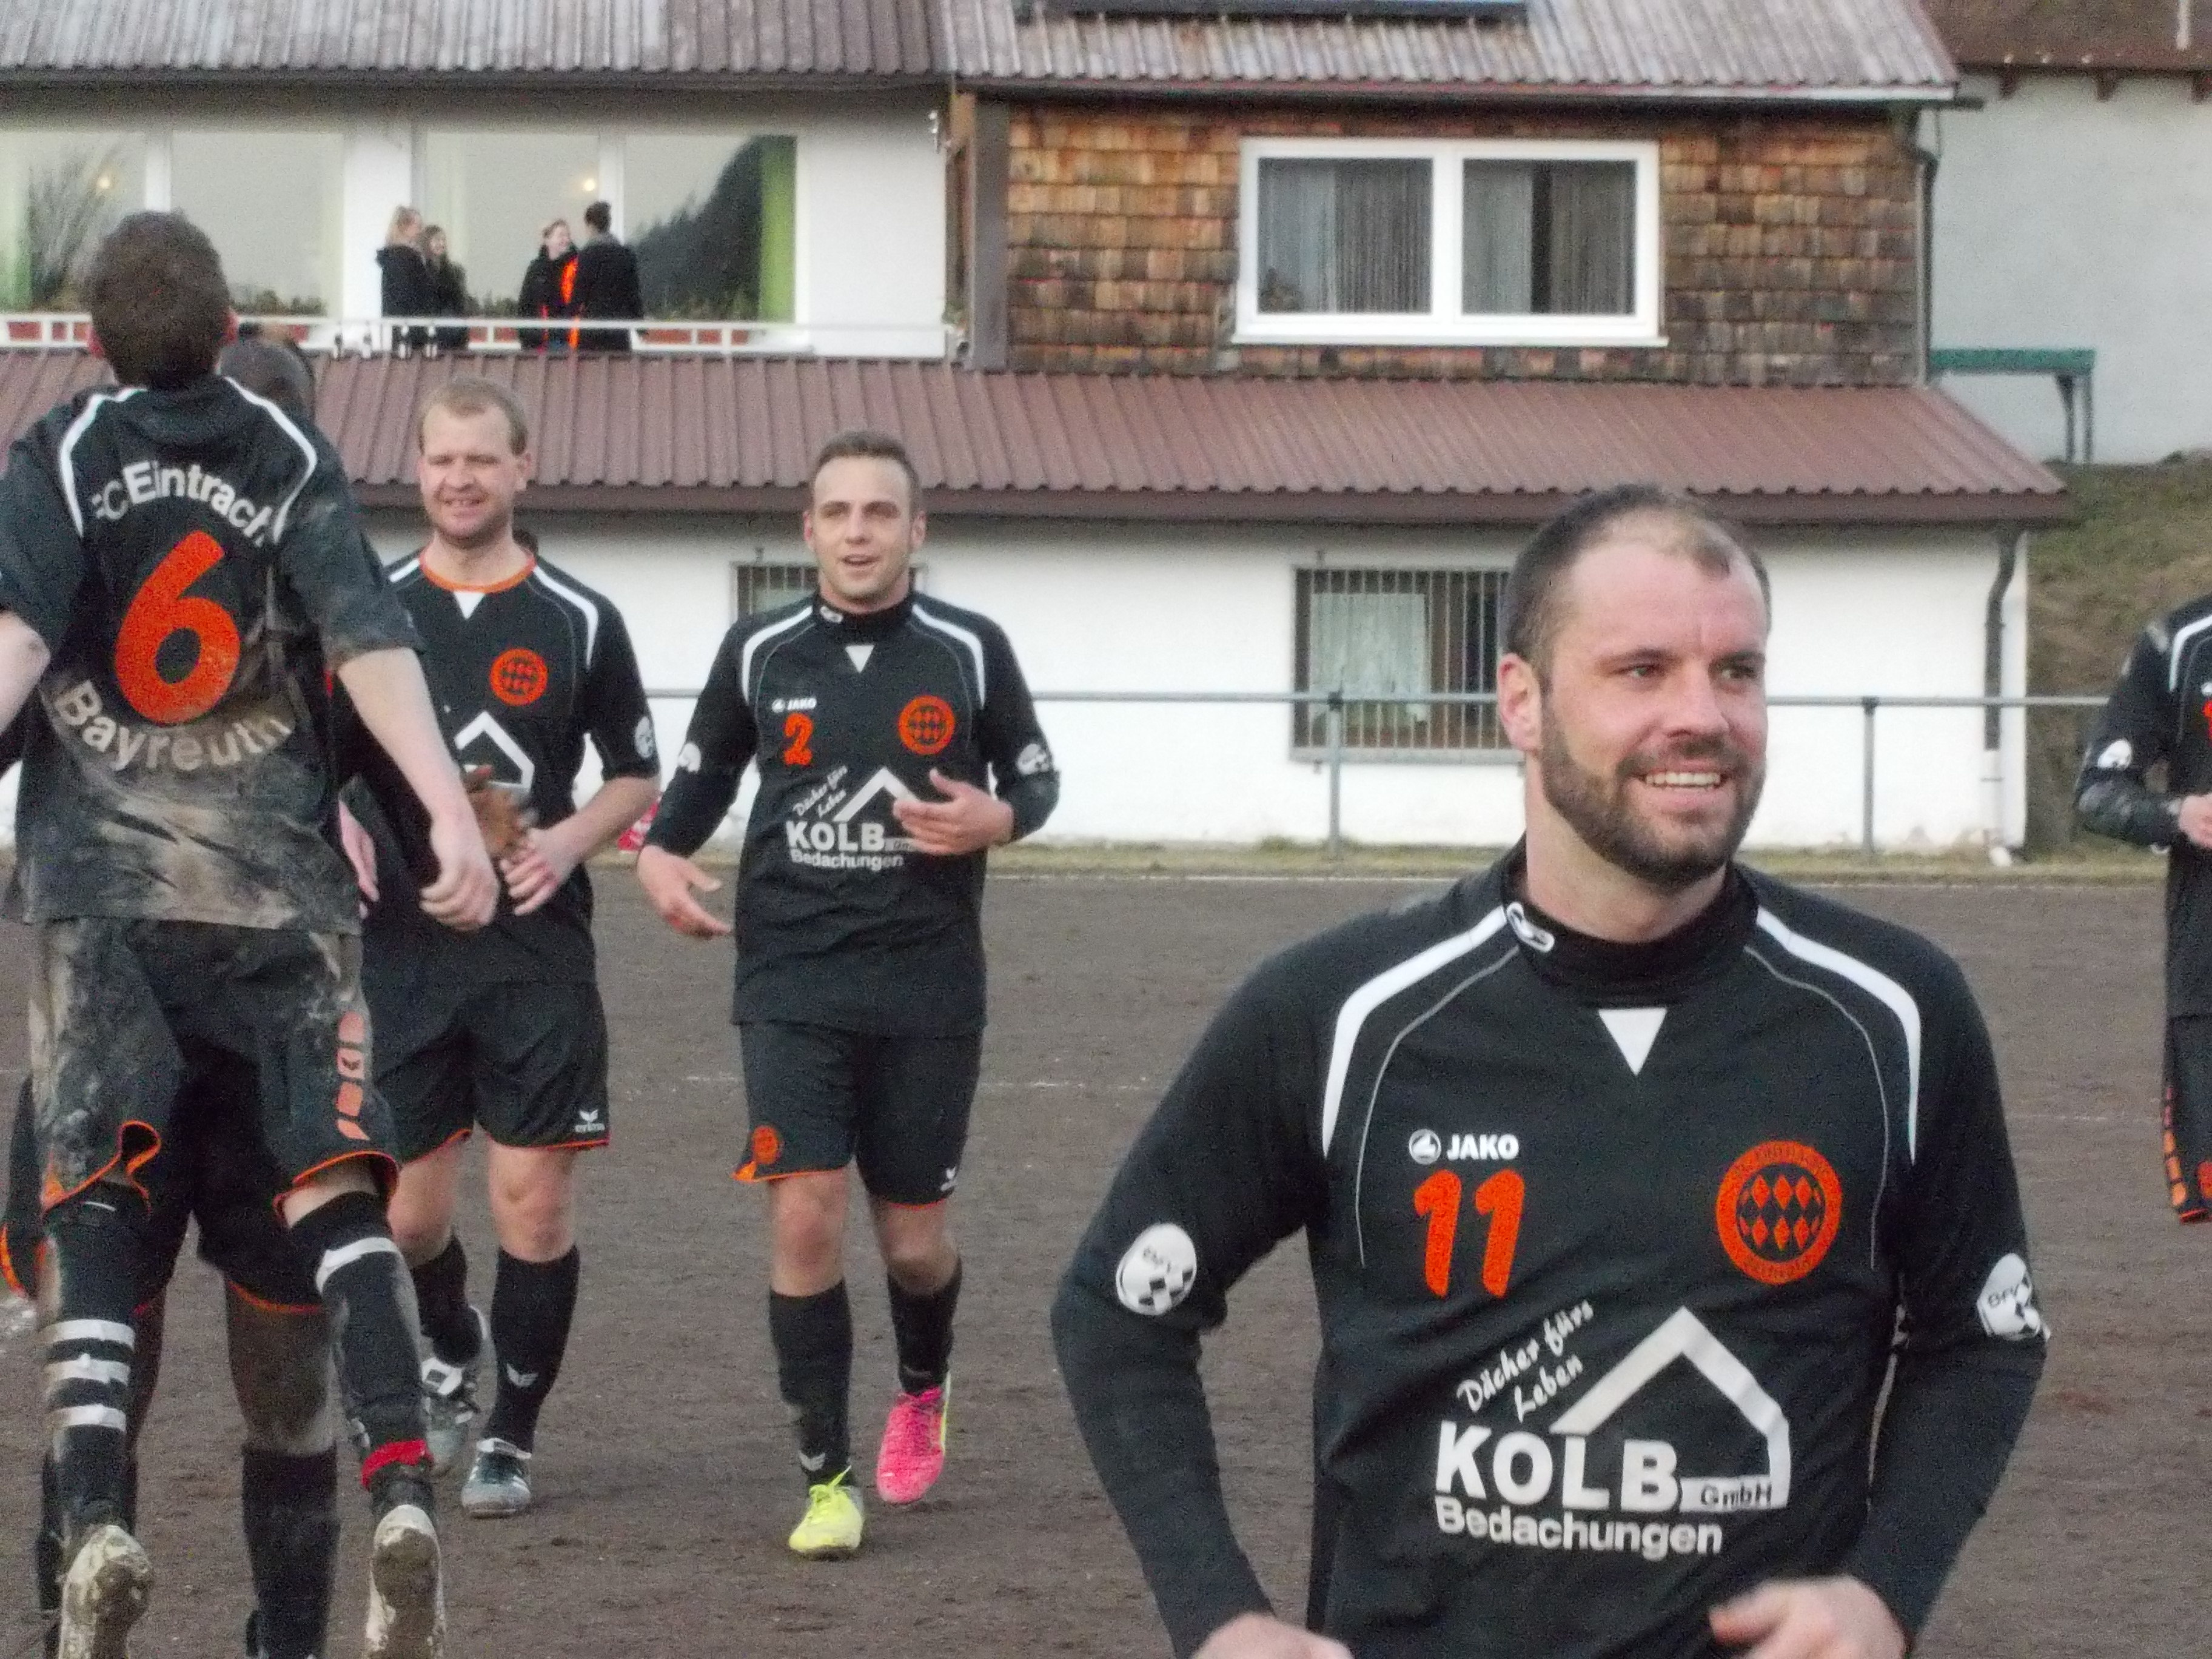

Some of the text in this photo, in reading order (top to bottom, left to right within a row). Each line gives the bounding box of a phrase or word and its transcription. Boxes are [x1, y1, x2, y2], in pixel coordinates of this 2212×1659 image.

[115, 529, 241, 726] 6
[783, 712, 813, 766] 2
[786, 820, 885, 851] KOLB
[789, 848, 904, 872] Bedachungen
[1446, 1133, 1520, 1161] JAKO
[1413, 1168, 1525, 1298] 11
[1514, 1353, 1583, 1424] Leben
[1435, 1421, 1772, 1513] KOLB GmbH
[1435, 1496, 1723, 1563] Bedachungen
